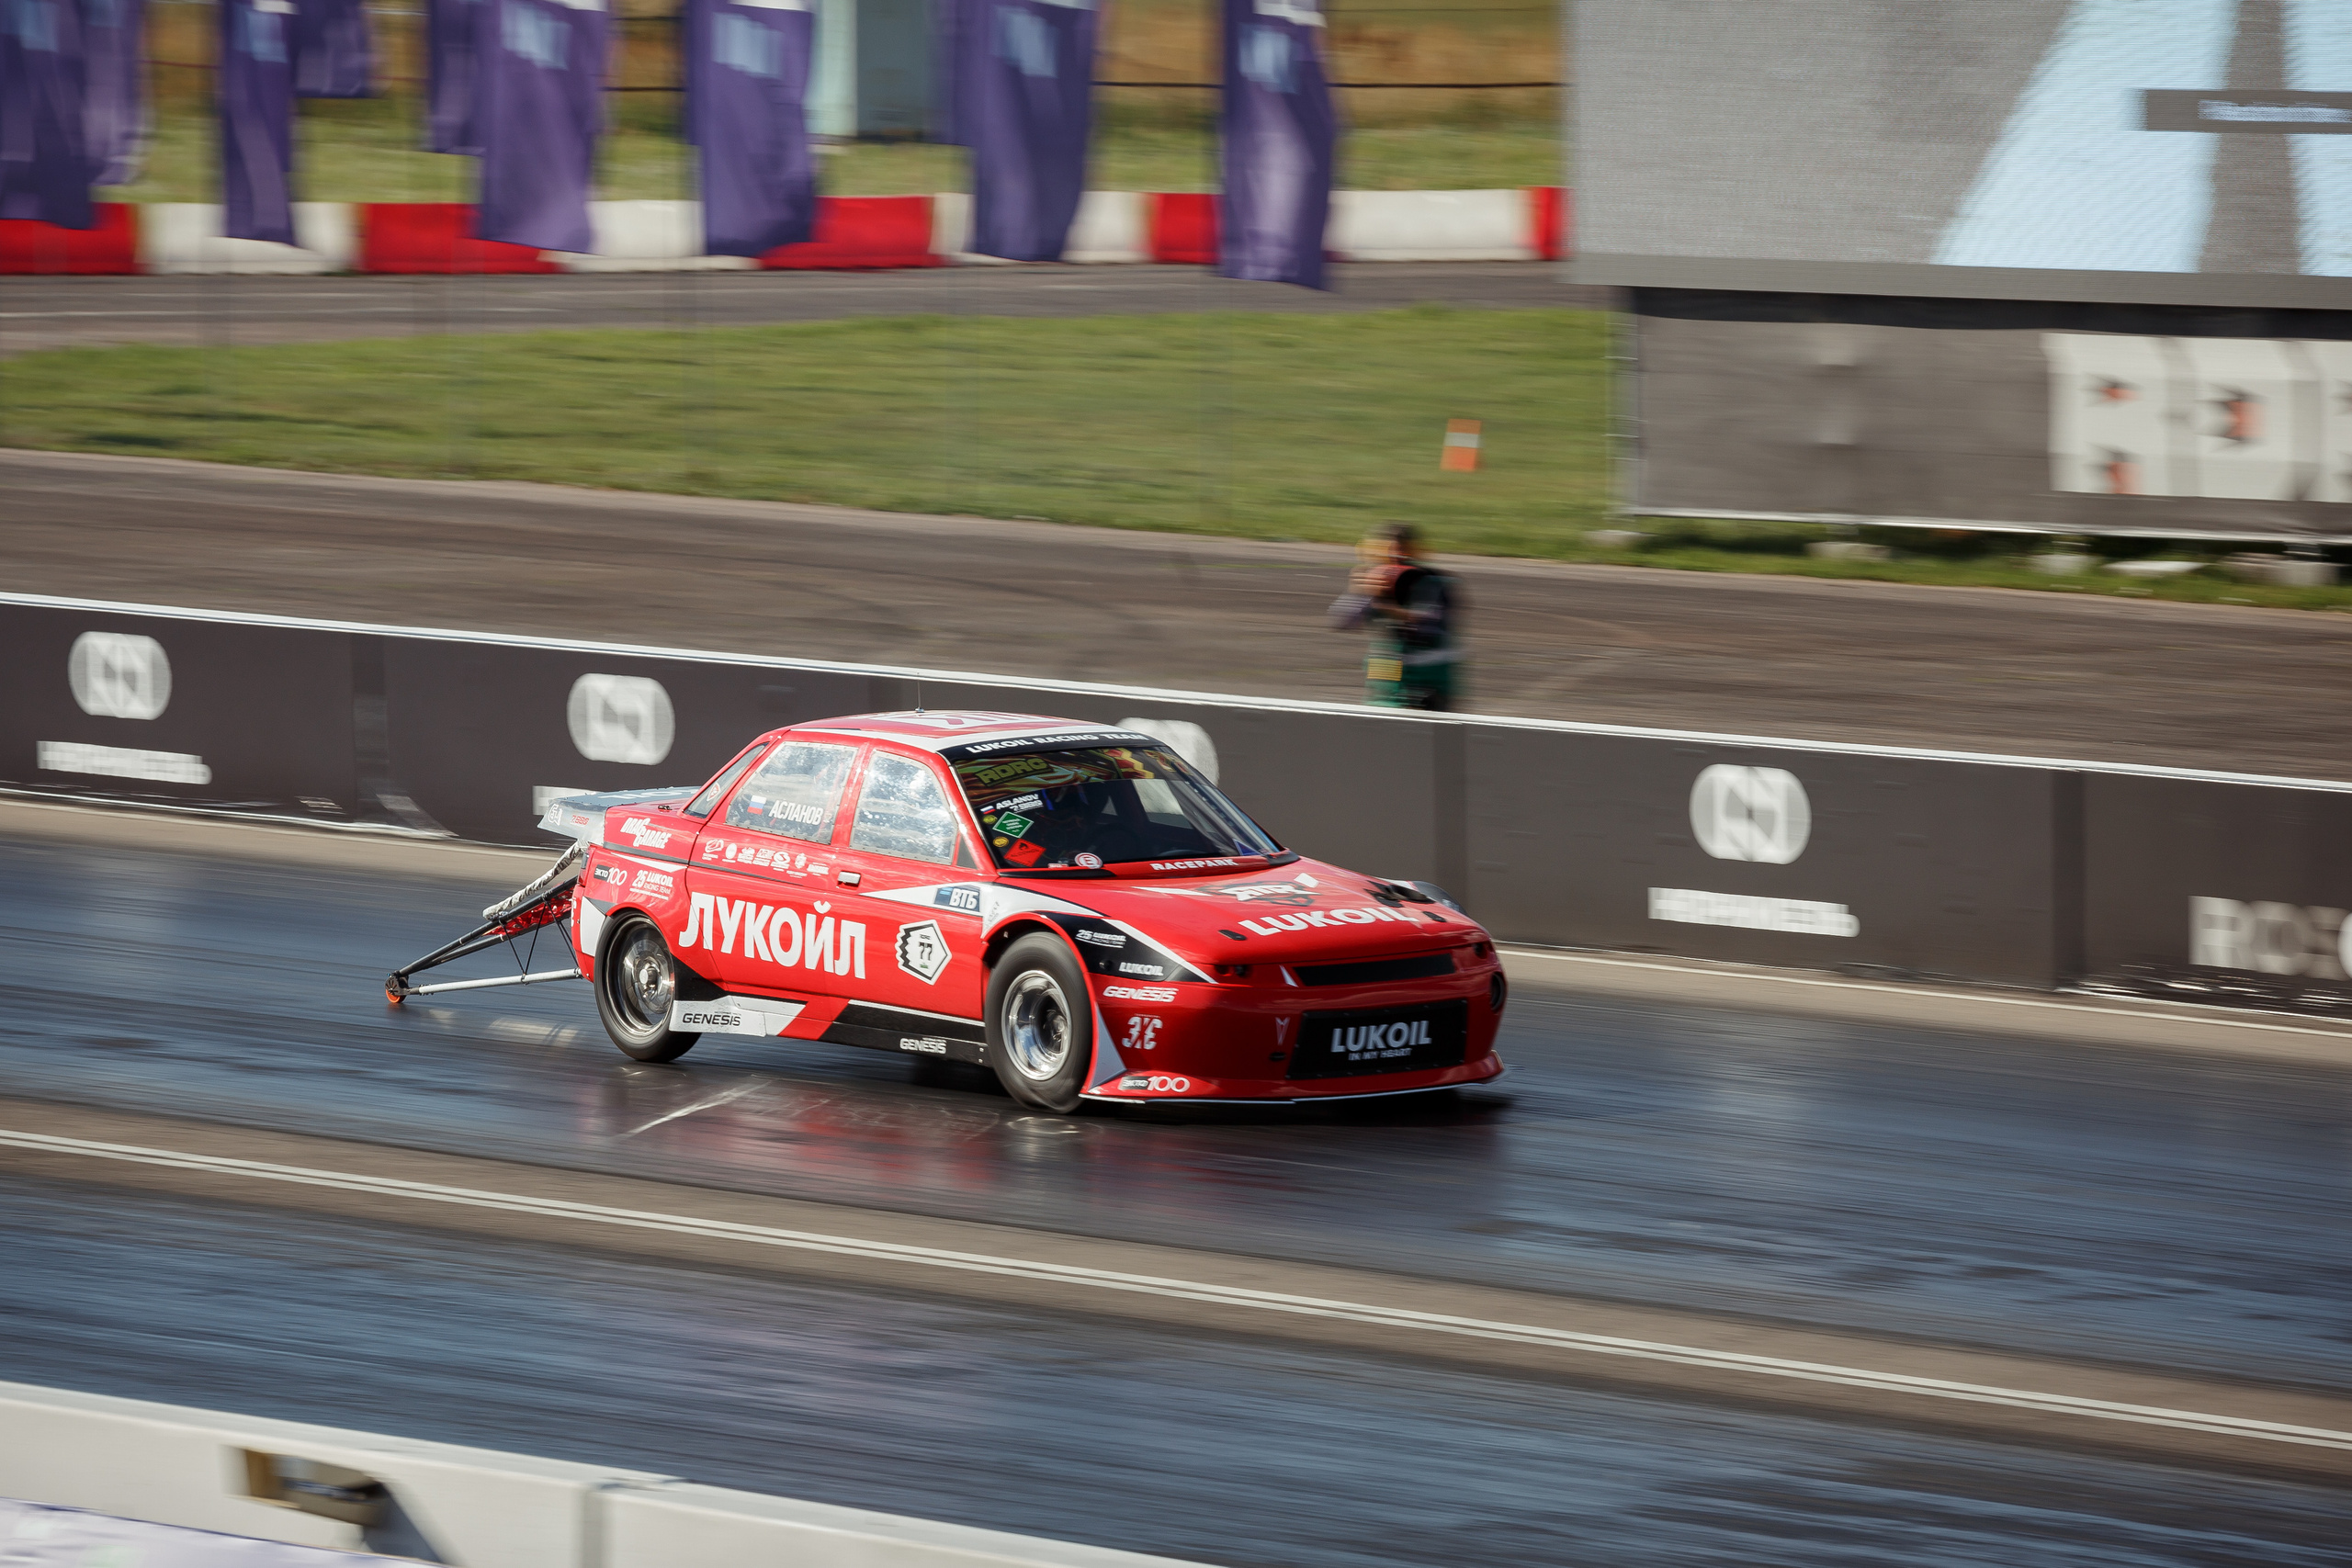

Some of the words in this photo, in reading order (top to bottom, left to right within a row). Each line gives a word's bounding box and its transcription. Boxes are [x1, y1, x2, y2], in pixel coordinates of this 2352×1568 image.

[966, 739, 1035, 754] LUKOIL
[1035, 733, 1100, 745] RACING
[1103, 732, 1149, 741] TEAM
[995, 794, 1039, 810] ASLANOV
[768, 799, 825, 826] АСЛАНОВ
[1150, 858, 1239, 871] RACEPARK
[606, 866, 628, 886] 100
[631, 869, 649, 888] 25
[646, 872, 673, 887] LUKOIL
[949, 887, 979, 910] ВТБ
[1238, 907, 1419, 937] LUKOIL
[678, 891, 866, 980] ЛУКОЙЛ
[919, 942, 933, 961] 77
[1118, 962, 1164, 976] LUKOIL
[1102, 986, 1177, 1002] GENESIS
[682, 1012, 741, 1027] GENESIS
[899, 1037, 947, 1055] GENESIS
[1330, 1021, 1432, 1053] LUKOIL
[1147, 1076, 1190, 1092] 100
